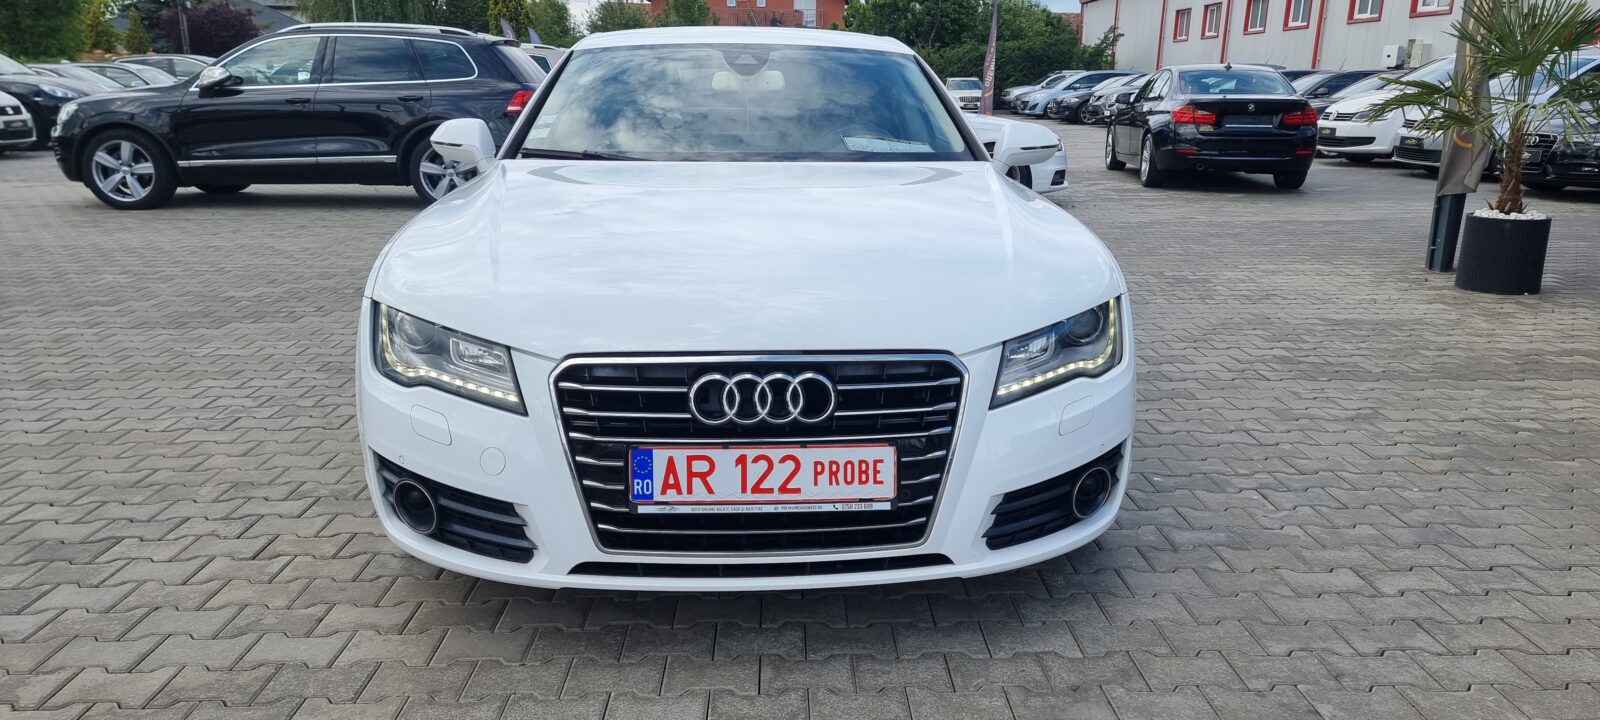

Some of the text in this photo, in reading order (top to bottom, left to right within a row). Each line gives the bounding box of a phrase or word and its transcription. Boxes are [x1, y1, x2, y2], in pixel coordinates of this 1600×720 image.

[633, 478, 653, 495] RO
[660, 453, 885, 496] AR 122 PROBE
